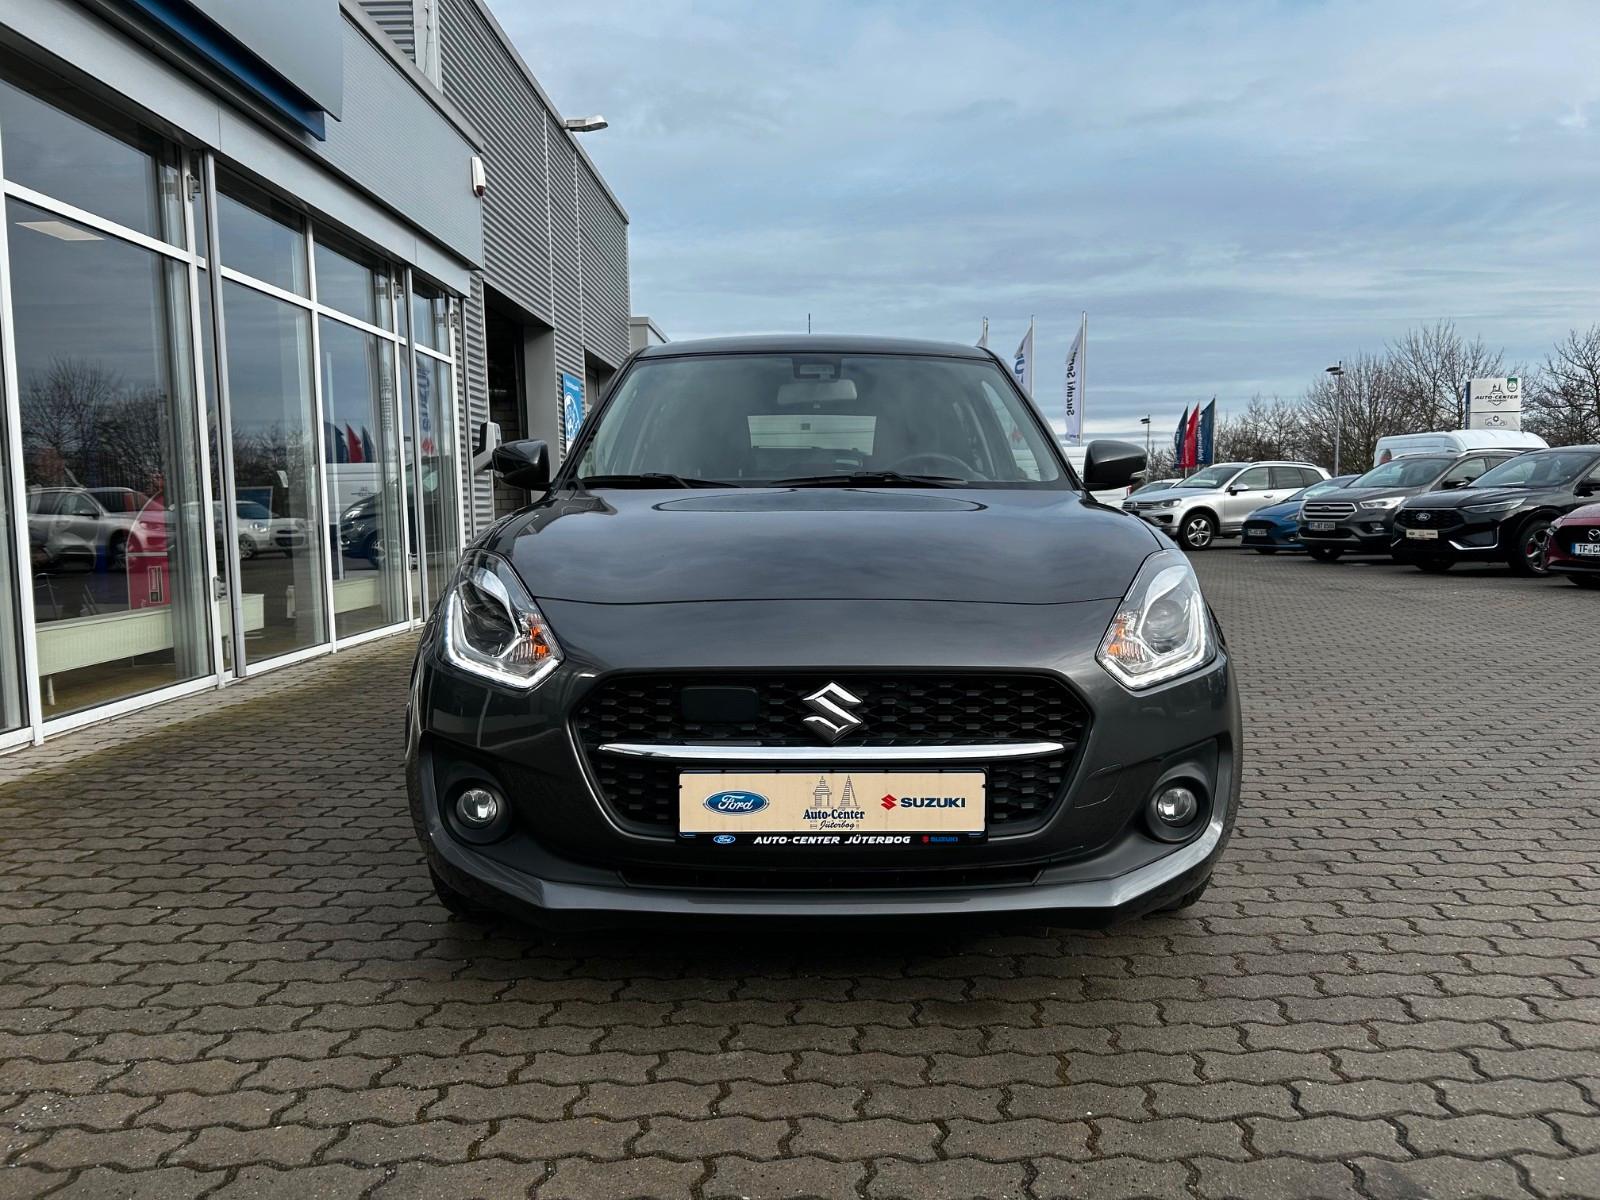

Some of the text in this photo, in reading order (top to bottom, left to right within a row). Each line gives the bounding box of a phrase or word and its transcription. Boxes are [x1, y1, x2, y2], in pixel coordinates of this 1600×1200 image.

[1577, 544, 1589, 552] TF
[718, 794, 754, 810] Ford
[900, 797, 966, 808] SUZUKI
[802, 809, 866, 820] Auto-Center
[818, 819, 855, 830] Jüterbog
[753, 834, 911, 844] AUTO-CENTER JÜTERBOG
